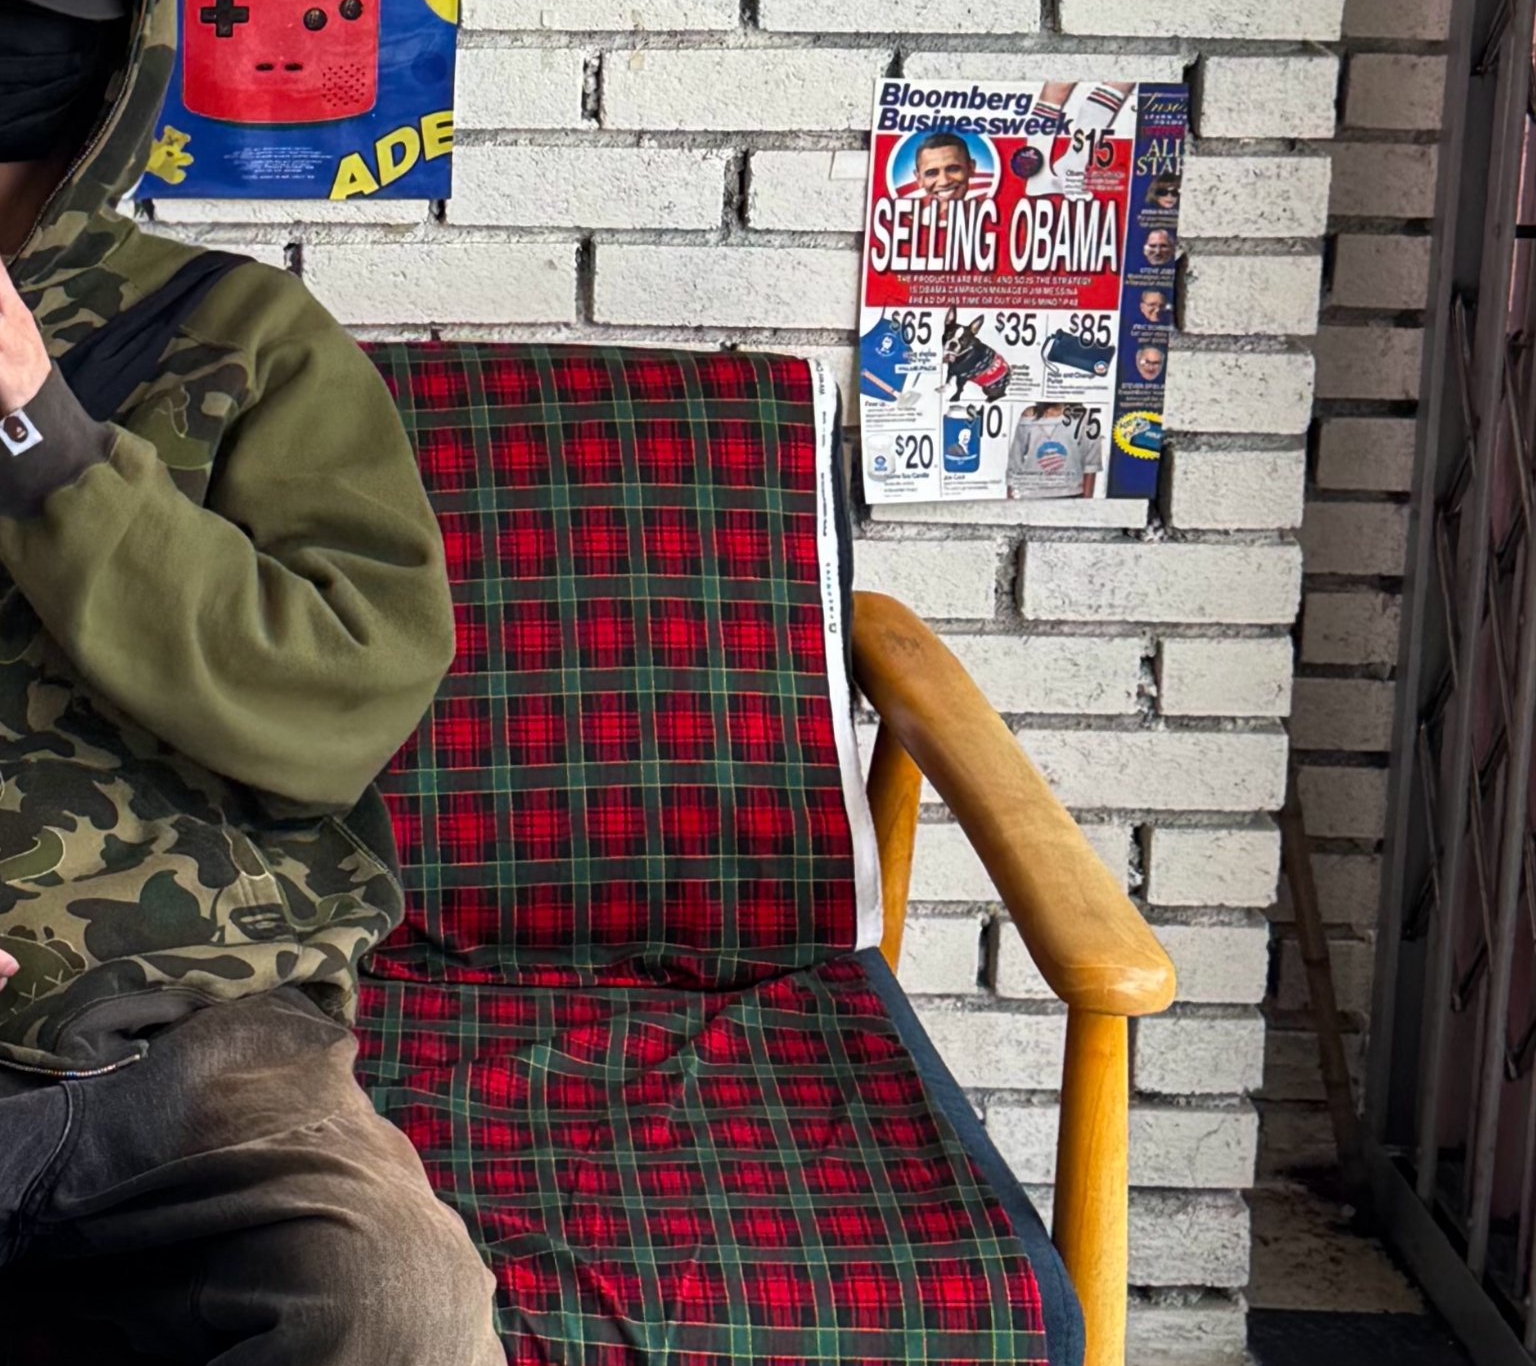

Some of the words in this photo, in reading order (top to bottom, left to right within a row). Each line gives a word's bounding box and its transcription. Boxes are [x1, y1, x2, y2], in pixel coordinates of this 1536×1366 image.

[878, 82, 1033, 116] Bloomberg
[876, 107, 1074, 137] Businessweek
[328, 108, 454, 201] ADE
[1072, 128, 1116, 169] $15
[870, 197, 997, 273] SELLING
[1008, 198, 1119, 274] OBAMA
[890, 310, 933, 346] $65
[994, 311, 1037, 347] $35
[1069, 312, 1112, 349] $85
[966, 403, 1004, 439] $10
[1061, 406, 1103, 441] $75
[894, 434, 935, 470] $20
